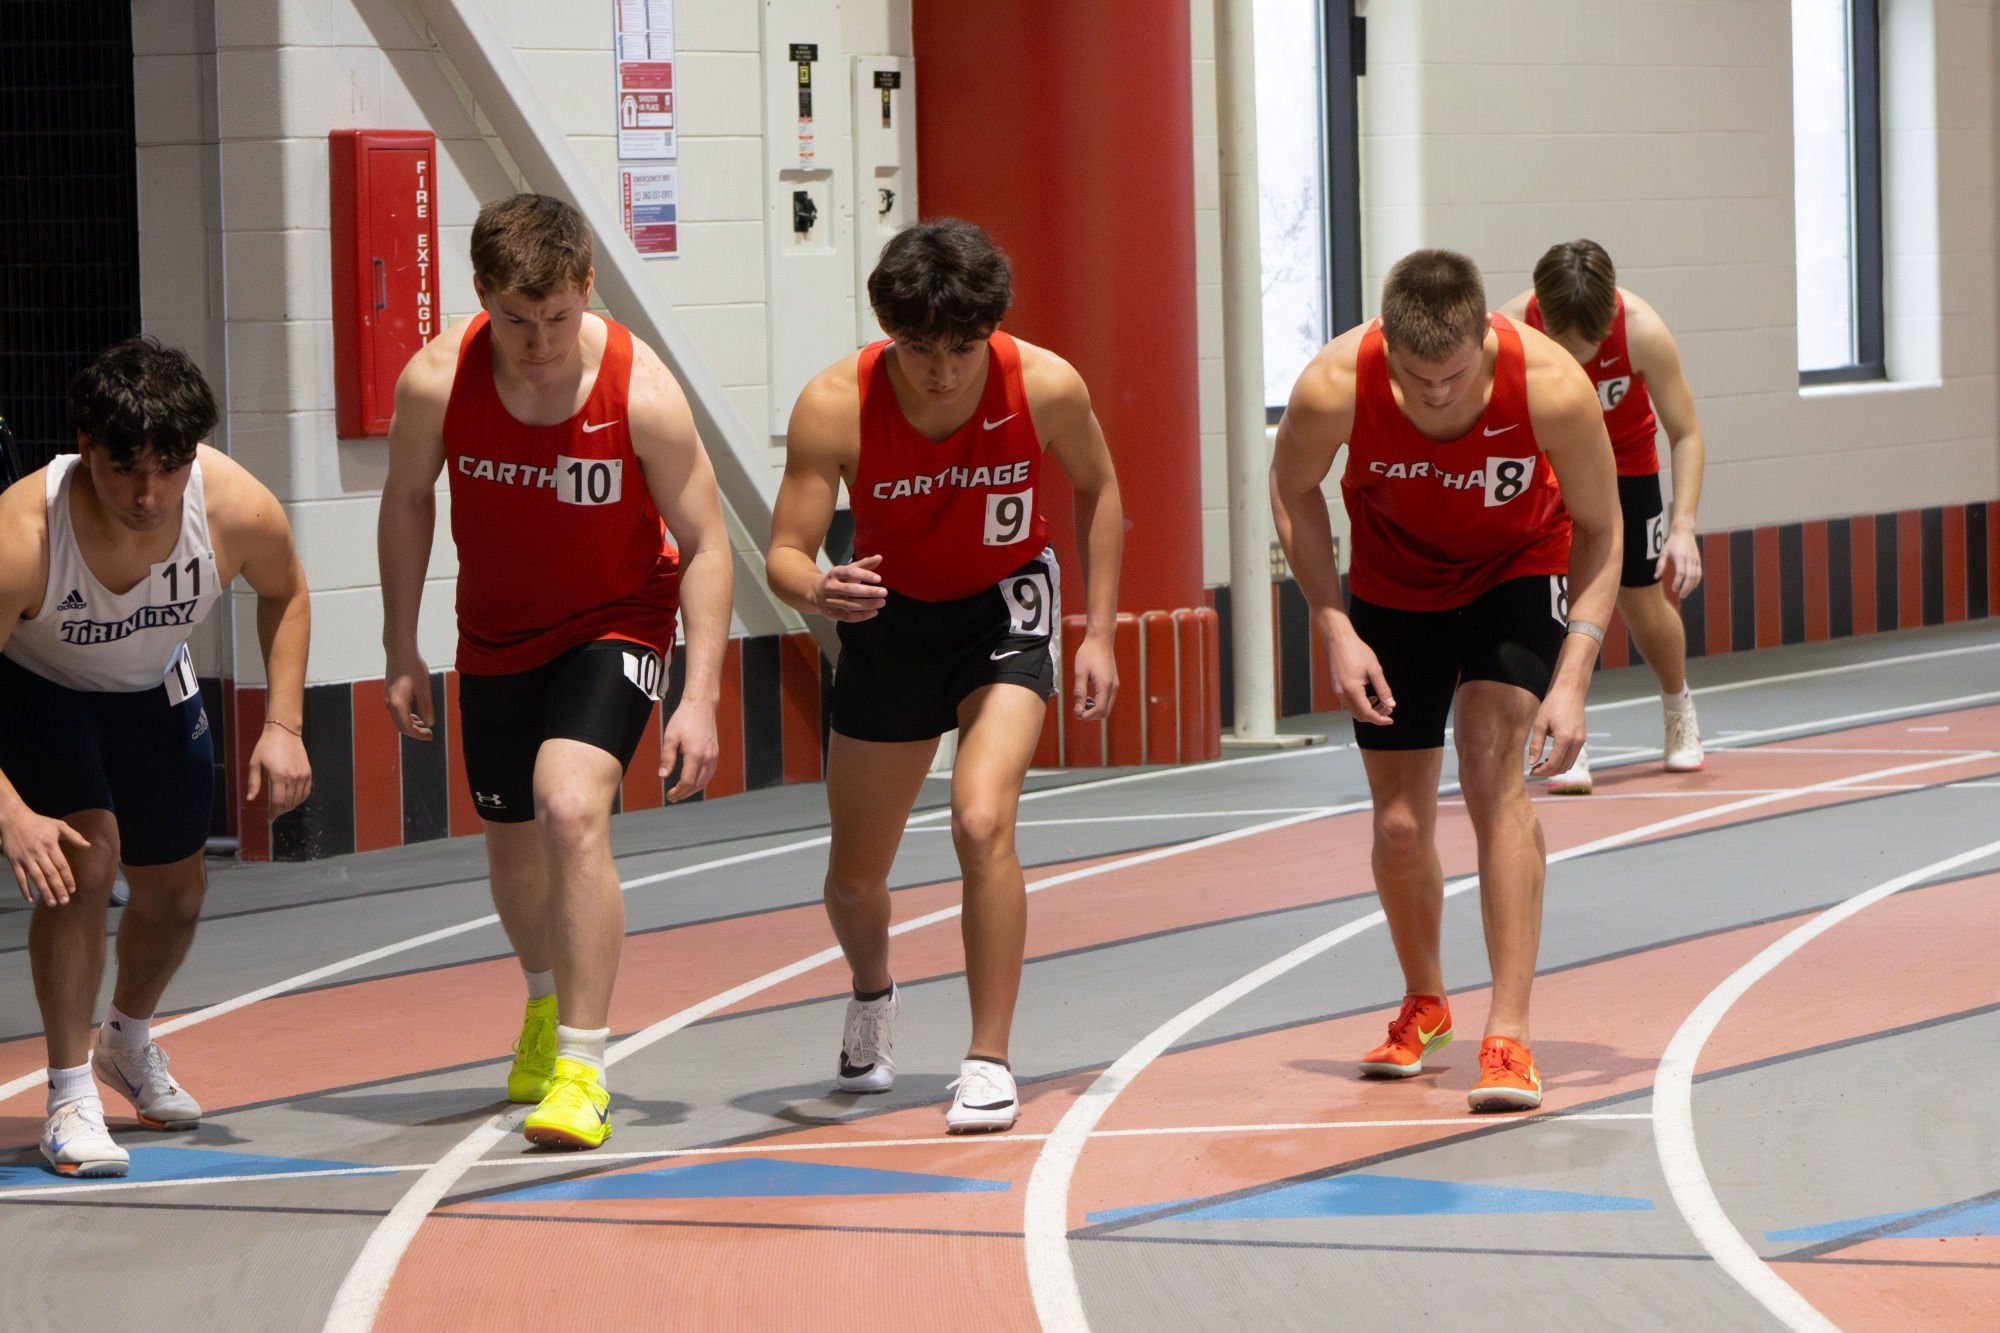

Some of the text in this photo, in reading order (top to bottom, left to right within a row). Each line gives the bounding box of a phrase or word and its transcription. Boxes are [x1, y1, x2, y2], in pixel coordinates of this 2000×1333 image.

[416, 161, 428, 218] FIRE
[1607, 379, 1624, 407] 6
[458, 454, 557, 489] CARTH
[566, 462, 611, 503] 10
[872, 460, 1032, 500] CARTHAGE
[1494, 461, 1525, 502] 8
[996, 496, 1025, 543] 9
[1653, 516, 1663, 556] 6
[162, 557, 200, 602] 11
[57, 601, 87, 611] adidas
[60, 598, 198, 645] TRINITY
[1012, 578, 1042, 631] 9
[170, 646, 198, 696] 11
[637, 645, 657, 695] 10
